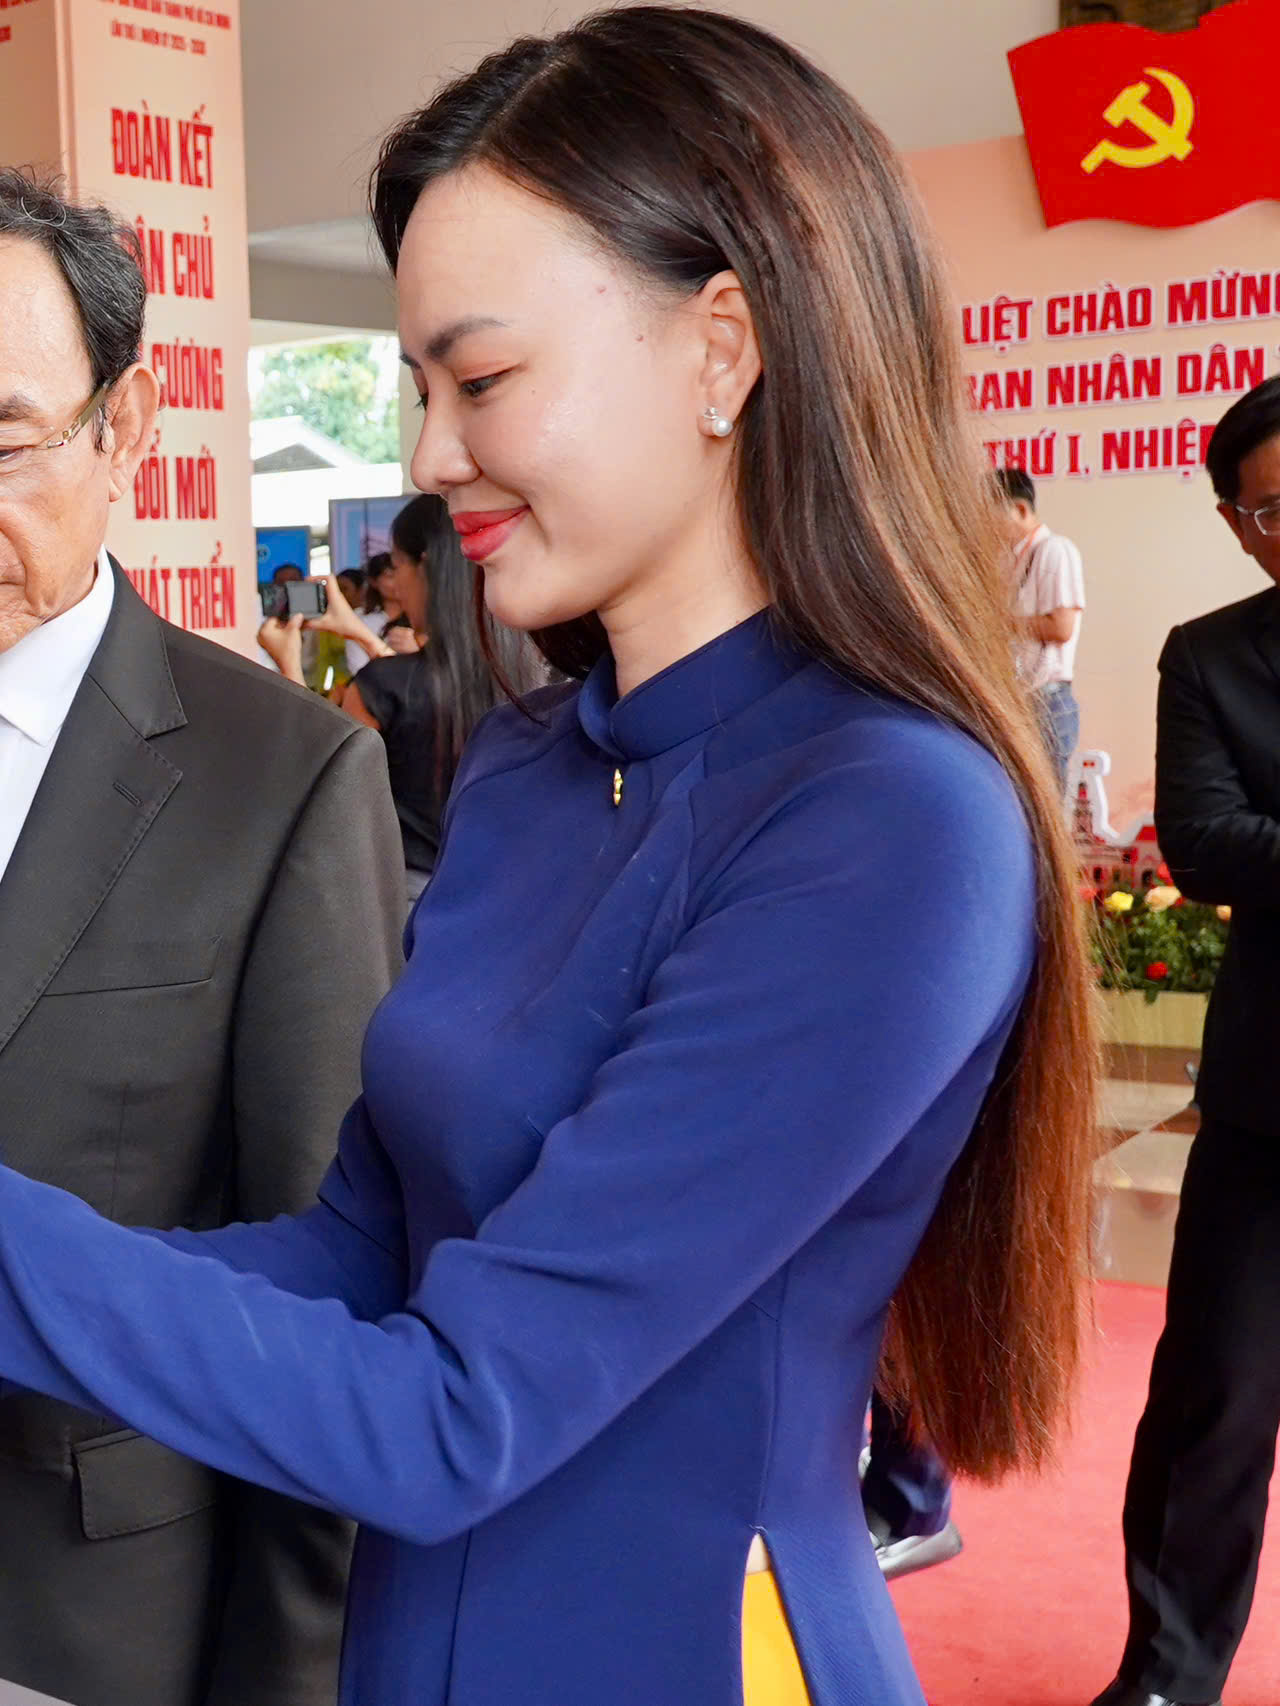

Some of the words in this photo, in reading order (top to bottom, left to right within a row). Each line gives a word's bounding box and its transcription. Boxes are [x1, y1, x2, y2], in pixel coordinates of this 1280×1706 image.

[111, 98, 172, 183] ĐOÀN
[178, 103, 214, 189] KẾT
[172, 214, 215, 300] CHỦ
[962, 295, 1033, 353] LIỆT
[1047, 280, 1152, 337] CHÀO
[1168, 268, 1280, 325] MỪN
[1047, 352, 1161, 407] NHÂN
[1177, 343, 1266, 396] DÂN
[134, 428, 168, 520] ĐỔI
[175, 444, 217, 520] MỚI
[1067, 433, 1090, 475] I,
[177, 539, 237, 630] TRIỂN
